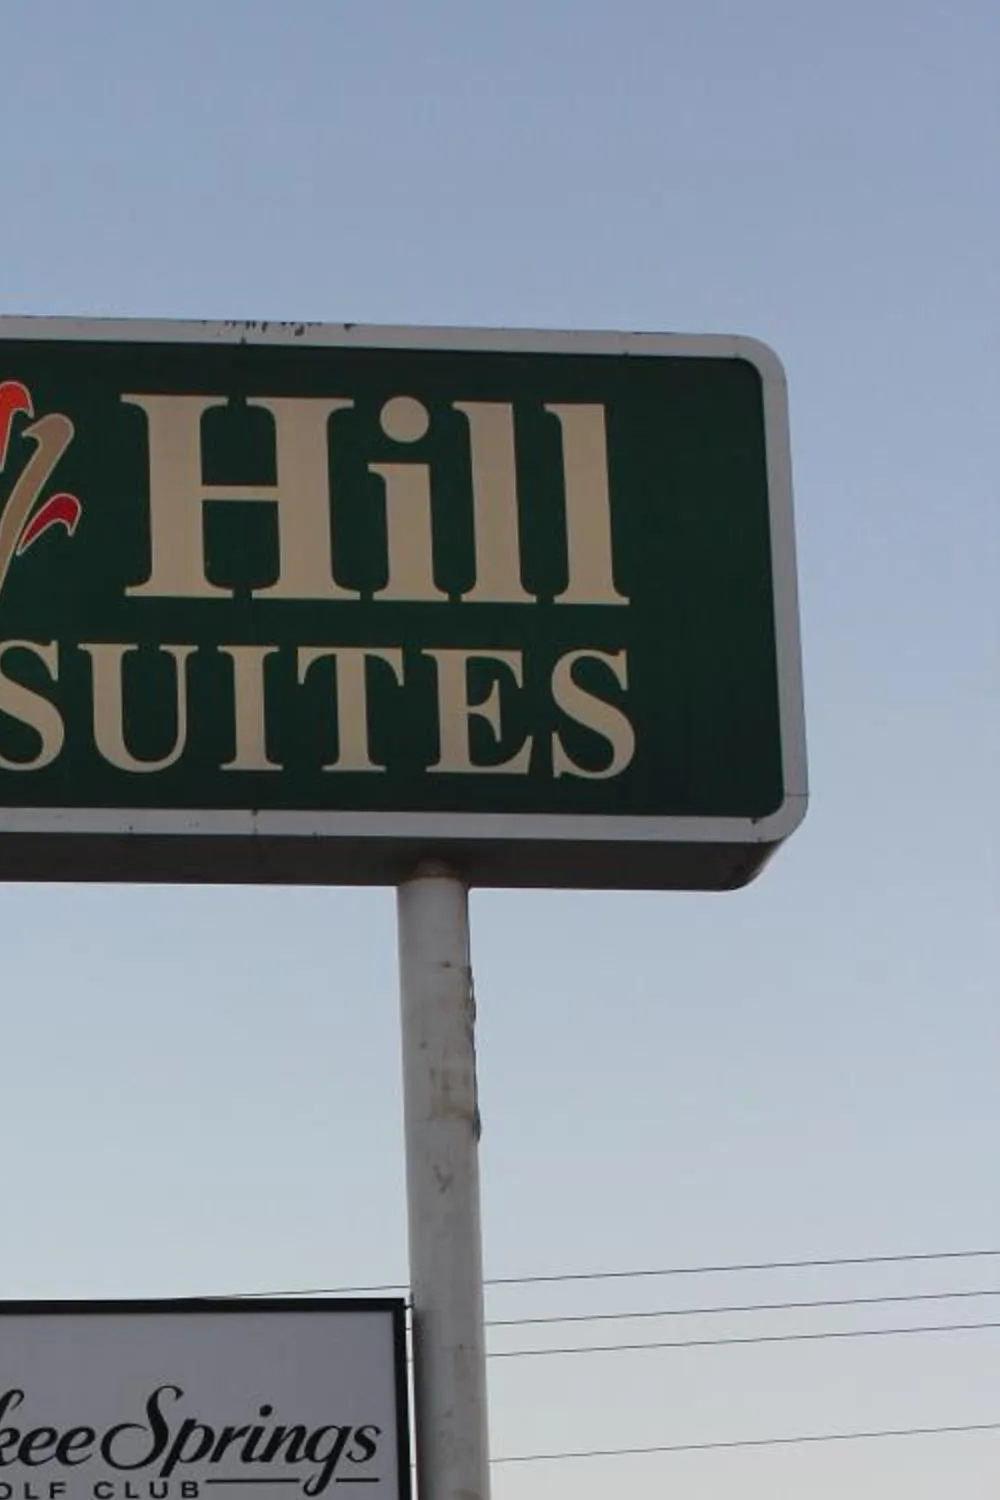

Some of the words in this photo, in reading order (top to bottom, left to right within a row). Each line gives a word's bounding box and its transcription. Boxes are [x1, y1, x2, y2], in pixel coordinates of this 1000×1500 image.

[120, 393, 630, 606] Hill
[92, 1480, 200, 1500] CLUB
[100, 1385, 382, 1498] Springs
